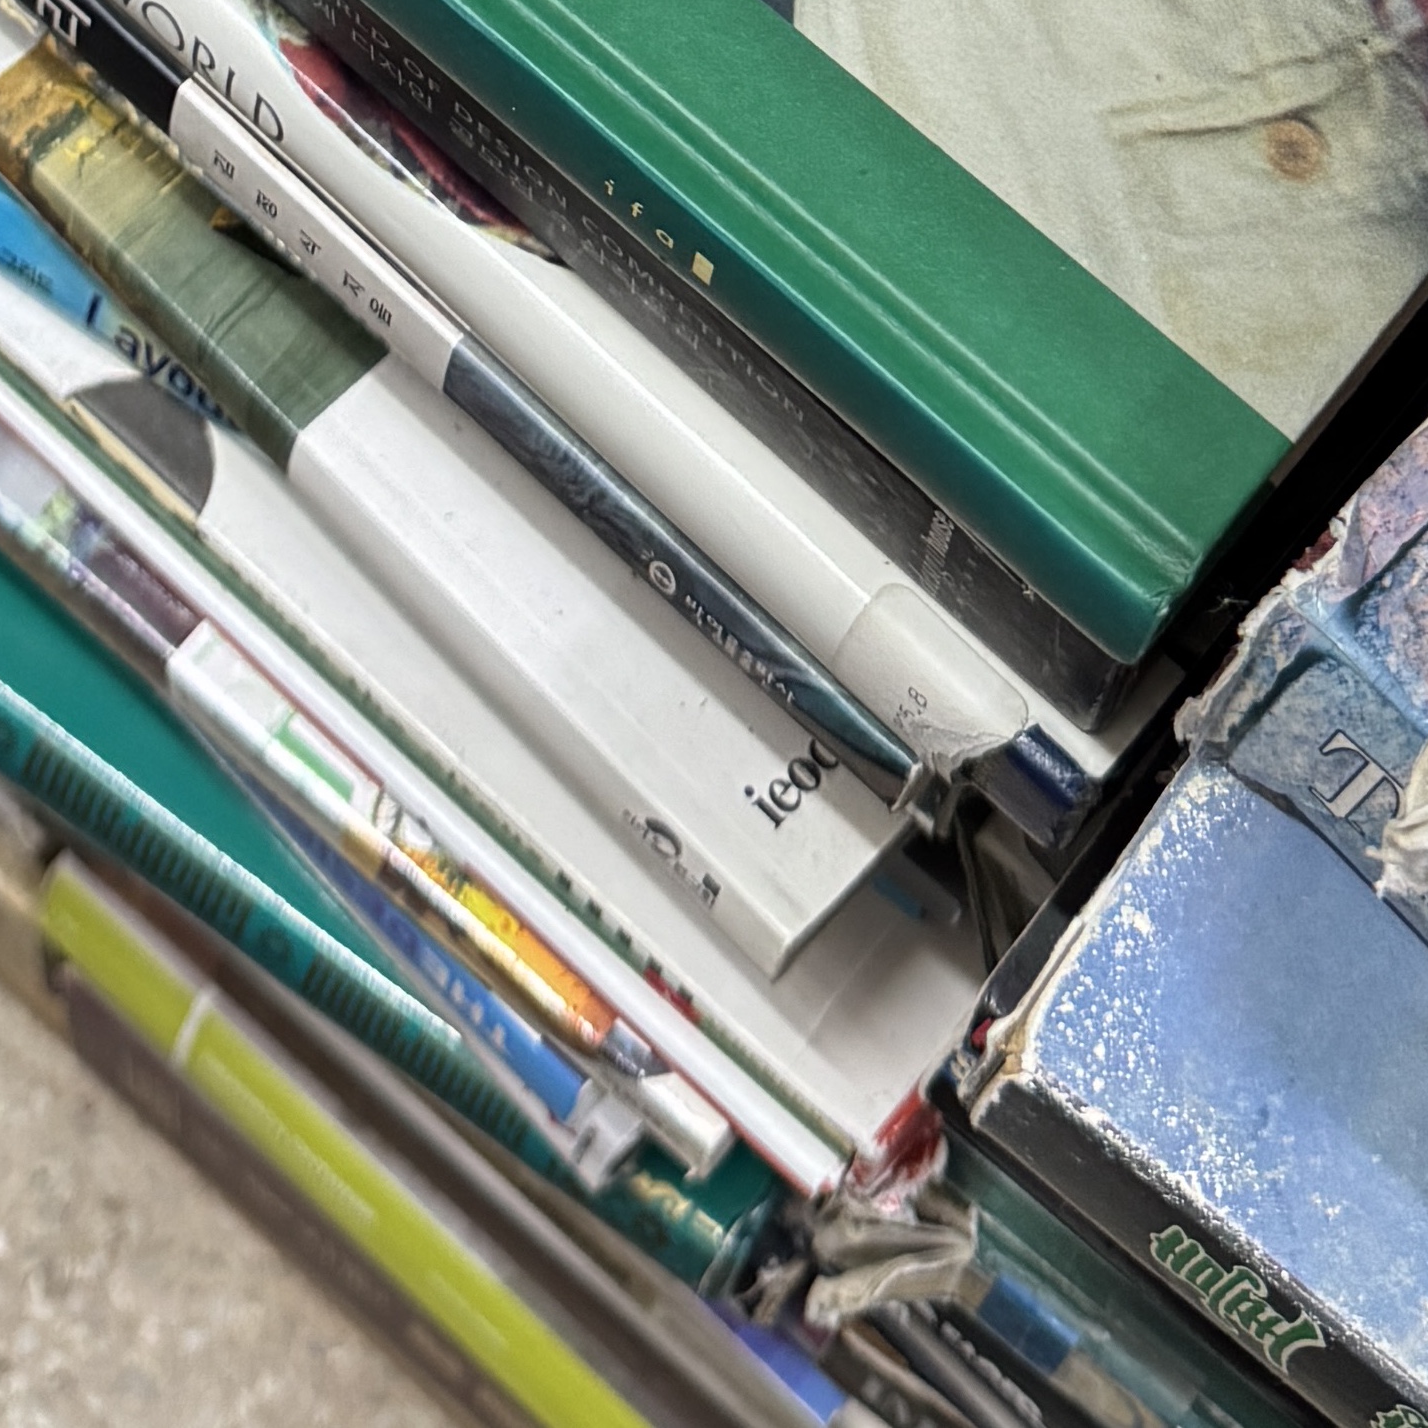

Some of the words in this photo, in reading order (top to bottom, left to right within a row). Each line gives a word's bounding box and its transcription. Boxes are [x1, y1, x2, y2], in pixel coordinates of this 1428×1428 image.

[350, 25, 435, 113] 디자인
[399, 55, 442, 94] OF
[452, 100, 569, 211] DESIGN
[581, 212, 804, 422] COMPETITION
